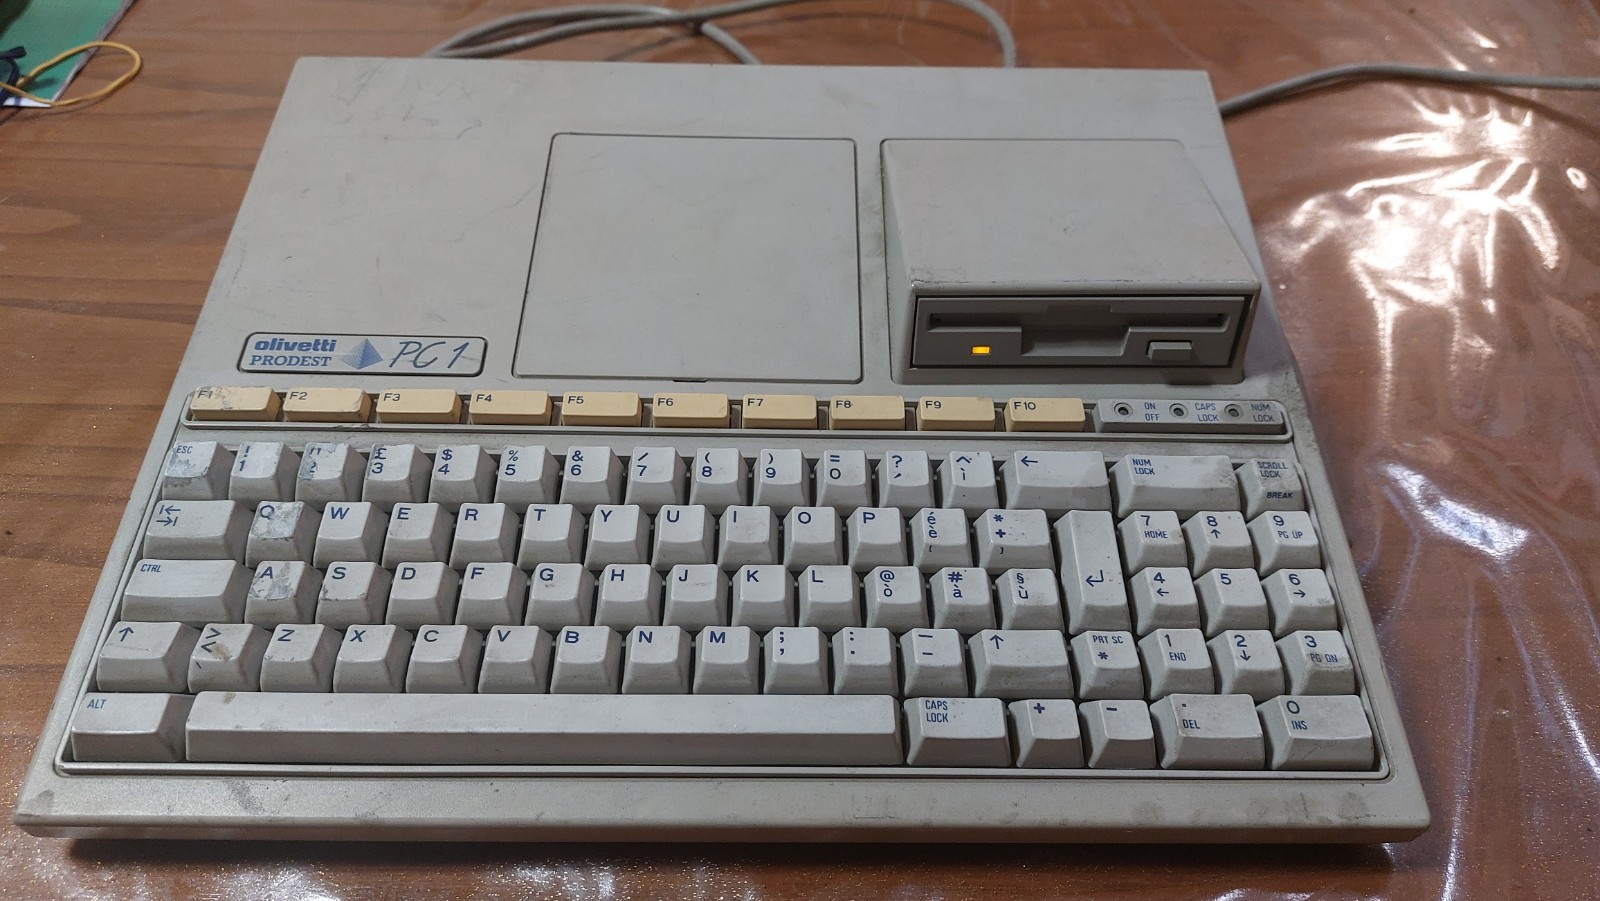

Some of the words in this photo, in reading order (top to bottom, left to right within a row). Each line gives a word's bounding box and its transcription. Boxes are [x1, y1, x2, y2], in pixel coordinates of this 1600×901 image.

[254, 338, 337, 352] olivetti
[249, 355, 333, 367] PRODEST
[197, 390, 213, 400] F1
[289, 392, 308, 400] F2
[383, 393, 401, 402] F3
[476, 394, 492, 403] F4
[567, 395, 584, 405] F5
[657, 397, 674, 407] F6
[747, 398, 763, 407] F7
[835, 400, 852, 409] F8
[925, 400, 942, 409] F9
[1013, 401, 1036, 410] F10
[1195, 403, 1216, 411] CAPS
[1197, 414, 1219, 422] LOCK
[1253, 414, 1275, 422] LOCK
[176, 445, 193, 454] ESC
[244, 446, 250, 457] !
[374, 447, 387, 460] £
[441, 449, 453, 461] $
[508, 450, 519, 462] %
[571, 450, 584, 462] &
[637, 452, 649, 462] /
[704, 452, 711, 463] (
[767, 453, 774, 464] )
[829, 454, 841, 463] =
[892, 455, 903, 467] ?
[1132, 458, 1152, 466] NUM
[239, 461, 245, 472] 1
[371, 463, 384, 474] 3
[438, 464, 450, 475] 4
[504, 464, 516, 475] 5
[571, 465, 582, 476] 6
[636, 465, 648, 477] 7
[1134, 467, 1155, 475] LOCK
[1257, 461, 1288, 470] SCROLL
[701, 466, 713, 478] 8
[765, 467, 776, 478] 9
[829, 468, 841, 480] 0
[1260, 470, 1281, 478] LOCK
[1266, 491, 1293, 499] BREAK
[259, 504, 275, 520] Q
[330, 507, 350, 520] W
[396, 507, 411, 520] E
[464, 509, 478, 521] R
[533, 509, 547, 521] T
[600, 510, 613, 522] Y
[666, 510, 680, 523] U
[797, 511, 812, 524] O
[862, 512, 875, 524] P
[927, 511, 937, 525] é
[1140, 515, 1150, 526] 7
[1206, 515, 1218, 527] 8
[1272, 515, 1285, 526] 9
[1144, 530, 1168, 539] HOME
[1277, 531, 1289, 539] PG
[1292, 531, 1303, 540] UP
[140, 563, 162, 573] CTRL
[259, 566, 274, 579] A
[331, 567, 347, 579] S
[401, 567, 416, 580] D
[470, 567, 485, 580] F
[539, 568, 554, 581] G
[610, 569, 625, 582] H
[678, 569, 688, 582] J
[746, 570, 760, 582] K
[811, 570, 824, 583] L
[879, 570, 895, 583] @
[948, 571, 963, 583] #
[1016, 572, 1024, 585] §
[1154, 572, 1165, 584] 4
[1220, 573, 1232, 585] 5
[1288, 573, 1301, 586] 6
[953, 584, 963, 598] à
[277, 630, 295, 642] Z
[349, 630, 367, 642] X
[423, 630, 439, 643] C
[497, 630, 511, 642] V
[564, 631, 579, 644] B
[638, 631, 652, 644] N
[709, 631, 726, 644] M
[1093, 635, 1109, 644] PRT
[1112, 635, 1124, 644] SC
[1164, 634, 1172, 647] 1
[1234, 634, 1248, 648] 2
[1304, 635, 1317, 648] 3
[1169, 652, 1187, 661] END
[1310, 653, 1322, 663] PG
[87, 699, 107, 709] ALT
[925, 700, 948, 711] CAPS
[1286, 700, 1300, 714] 0
[926, 712, 949, 723] LOCK
[1182, 719, 1200, 729] DEL
[1291, 720, 1308, 730] INS
